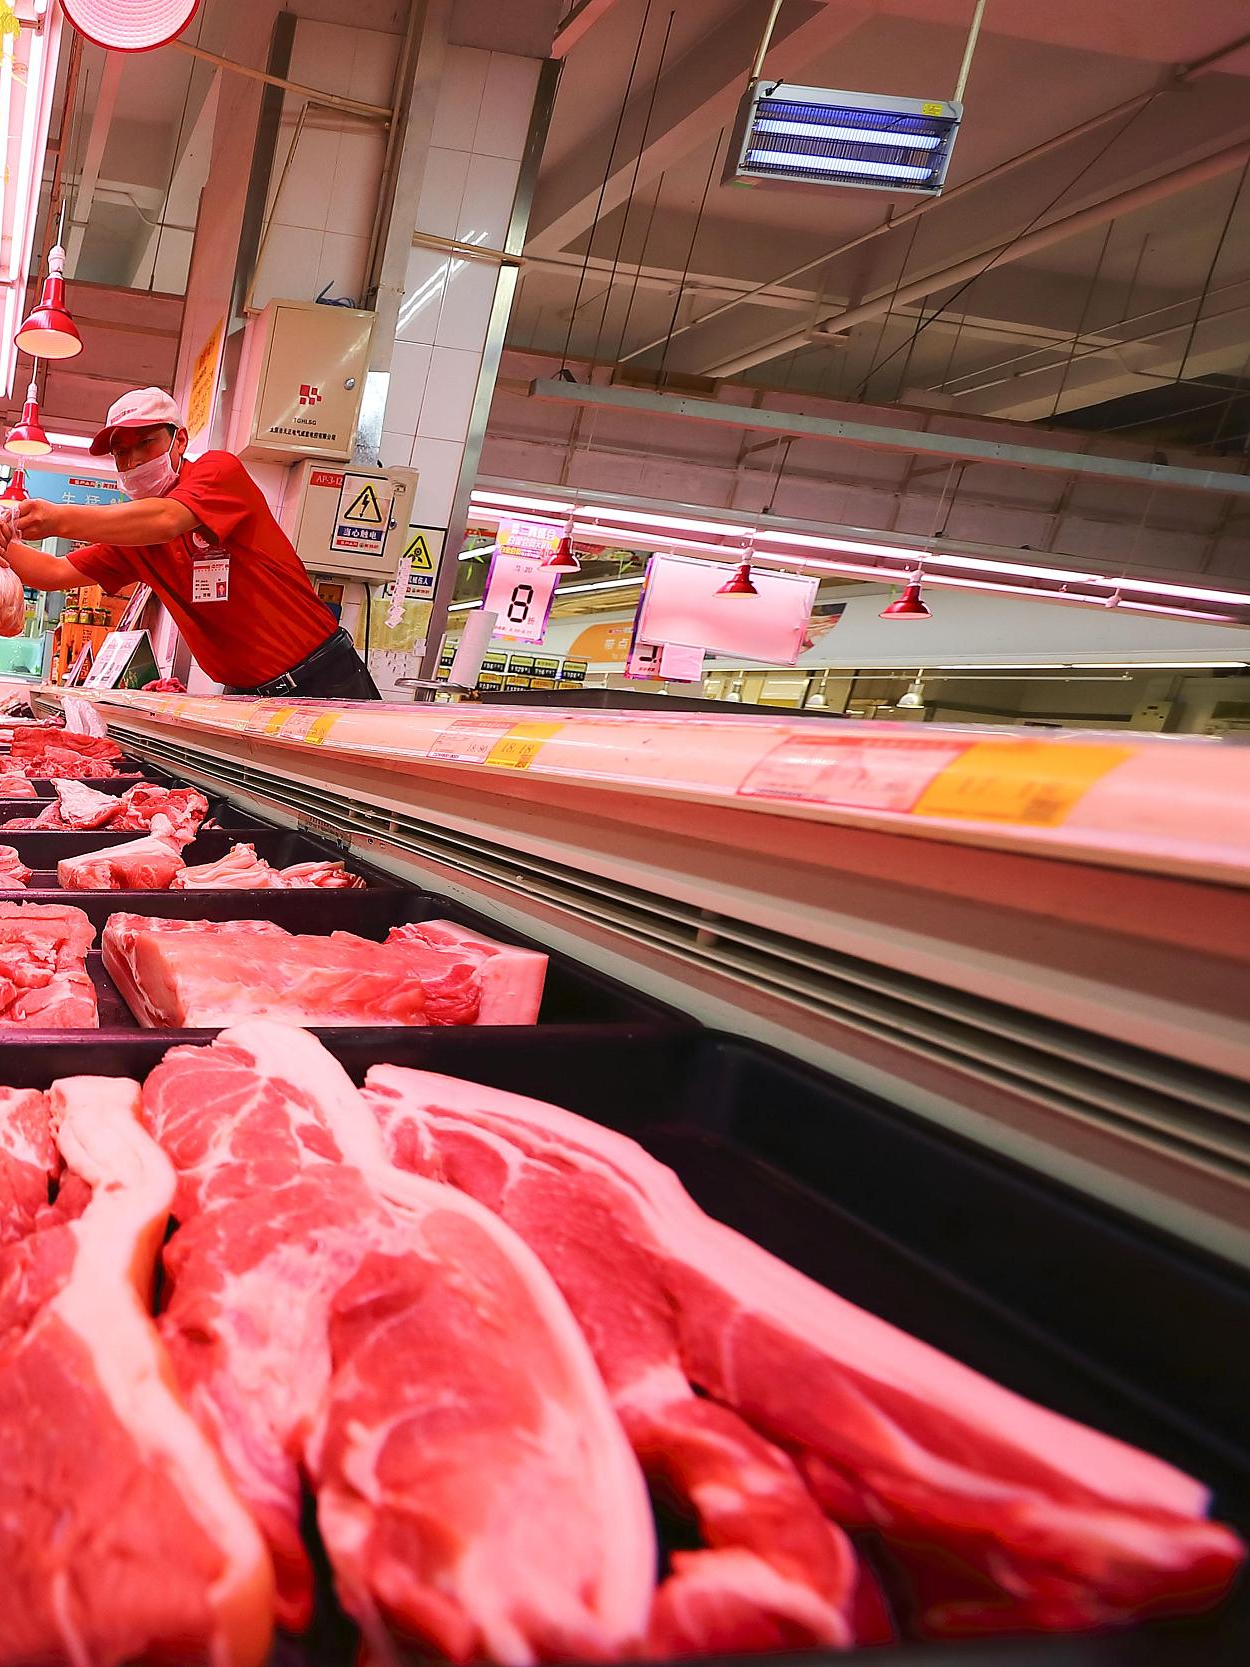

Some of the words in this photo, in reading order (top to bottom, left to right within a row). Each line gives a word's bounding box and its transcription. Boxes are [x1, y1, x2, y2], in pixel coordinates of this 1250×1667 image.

[343, 527, 378, 541] 当心触电
[507, 583, 535, 624] 8
